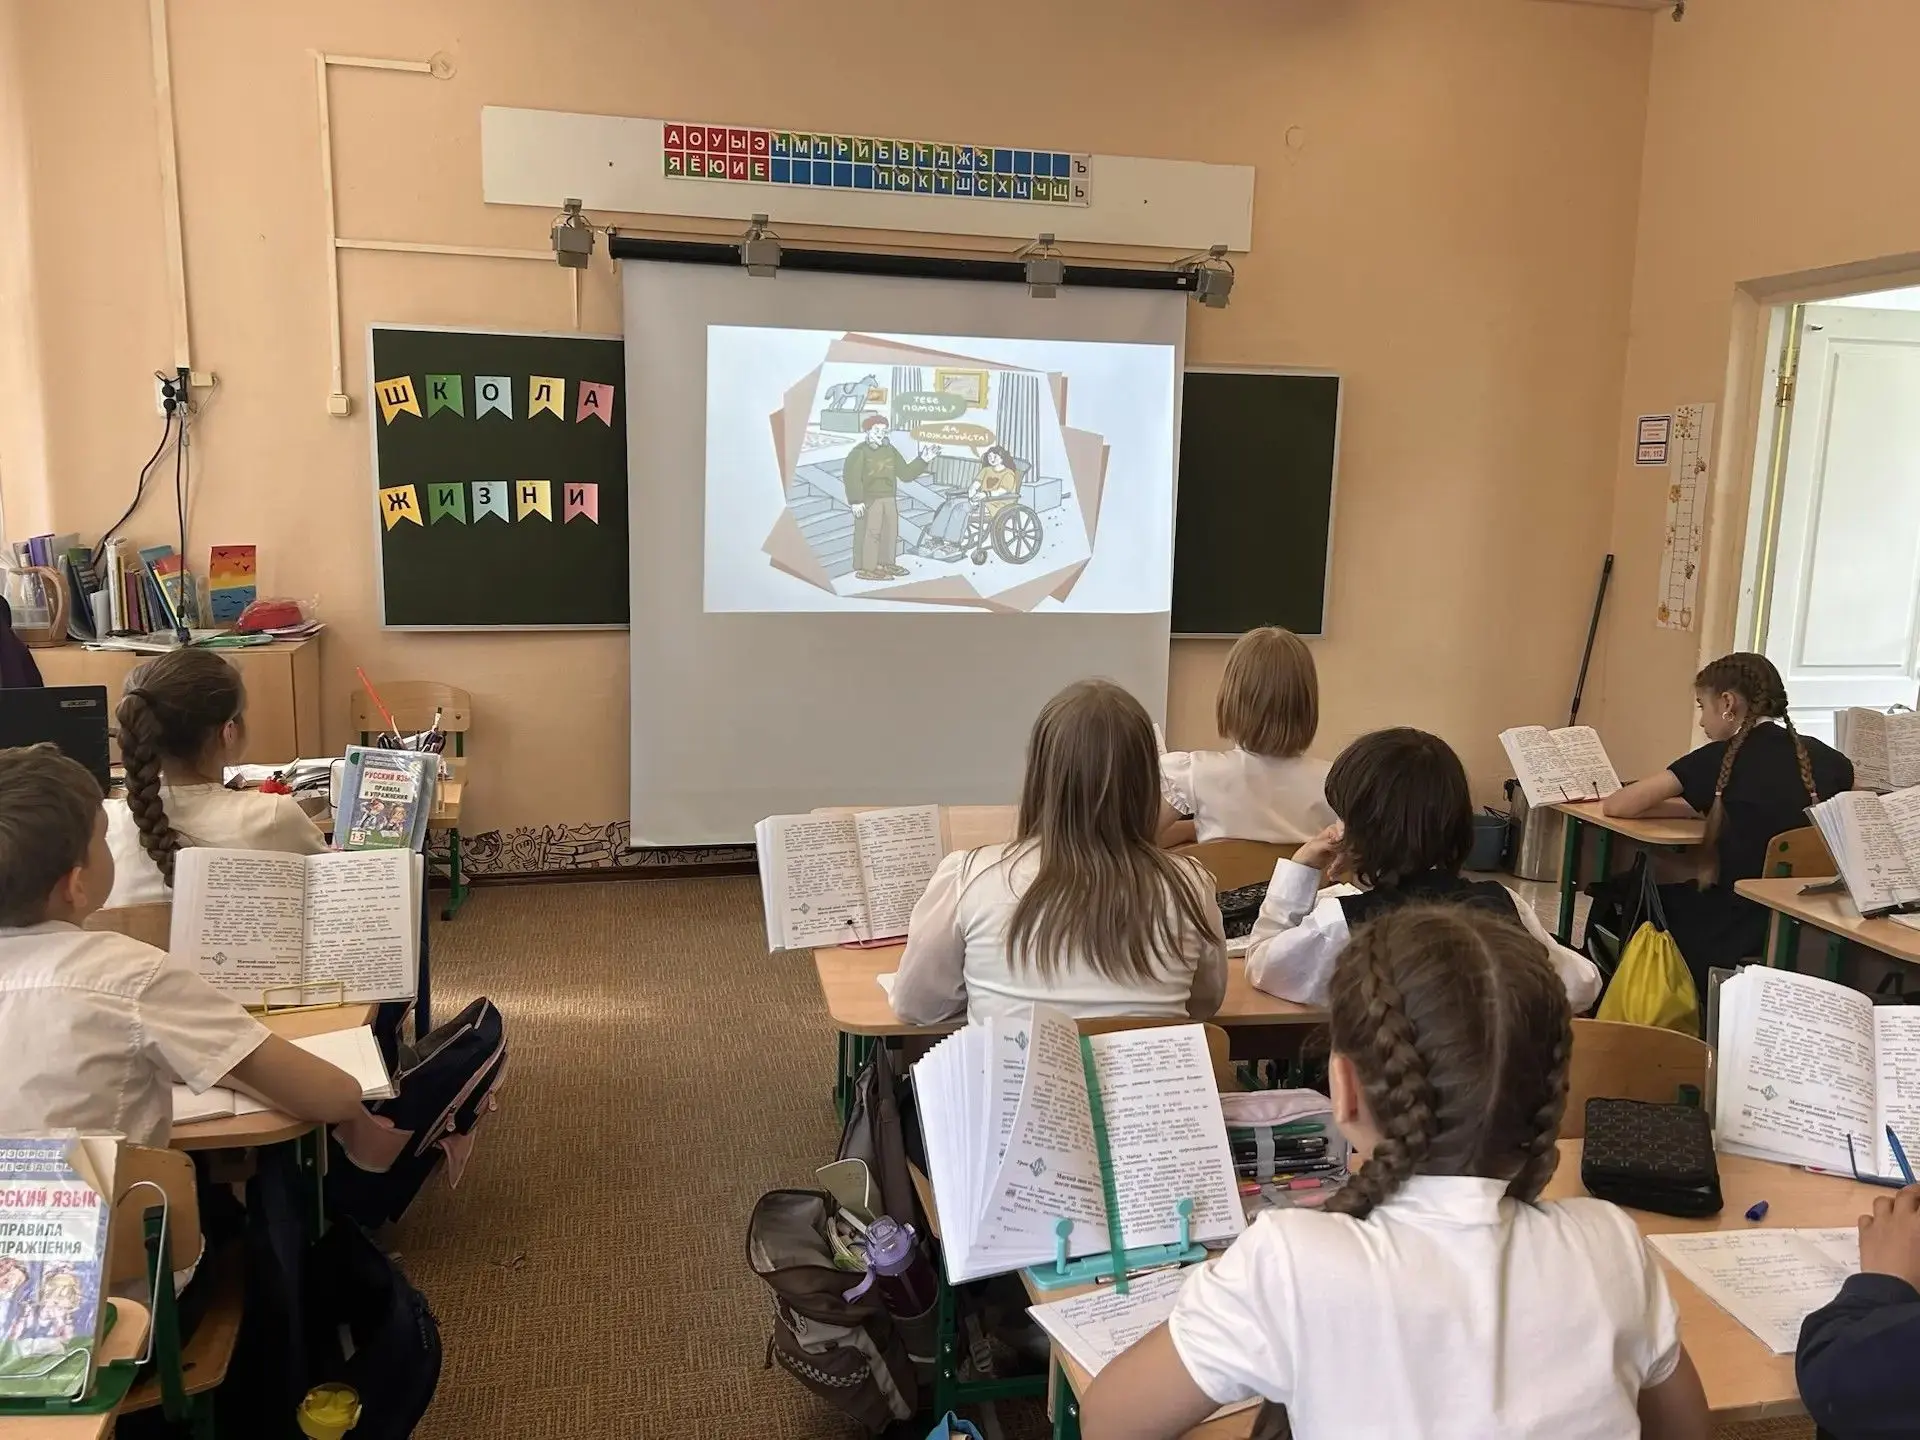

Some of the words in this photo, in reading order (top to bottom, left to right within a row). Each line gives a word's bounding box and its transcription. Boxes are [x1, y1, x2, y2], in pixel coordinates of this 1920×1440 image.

[667, 130, 681, 145] А
[688, 132, 702, 146] О
[712, 134, 723, 147] У
[731, 135, 745, 149] Ы
[754, 137, 766, 151] Э
[775, 139, 787, 152] Н
[795, 141, 808, 154] М
[816, 142, 828, 155] Л
[838, 143, 848, 156] Р
[858, 138, 869, 158] Й
[878, 147, 889, 160] Б
[899, 148, 909, 161] В
[919, 149, 928, 162] Г
[938, 150, 950, 166] Д
[956, 152, 971, 166] Ж
[979, 154, 988, 167] З
[1074, 161, 1087, 173] Ъ
[668, 157, 681, 171] Я
[691, 155, 701, 172] Ё
[709, 159, 725, 174] Ю
[733, 161, 744, 175] И
[754, 163, 765, 176] Е
[878, 171, 889, 185] П
[897, 172, 910, 186] Ф
[919, 175, 928, 188] К
[939, 176, 949, 189] Т
[956, 177, 970, 190] Ш
[978, 178, 988, 192] С
[997, 180, 1008, 193] Х
[1017, 181, 1028, 197] Ц
[1037, 182, 1047, 195] Ч
[1053, 183, 1068, 199] Щ
[1074, 185, 1085, 198] Ь
[384, 381, 599, 409] ШКОЛА
[386, 486, 584, 512] ЖИЗНИ
[364, 771, 395, 781] РУССКИЙ
[52, 1189, 98, 1208] ЯЗЫК
[0, 1223, 63, 1237] ПРАВИЛА
